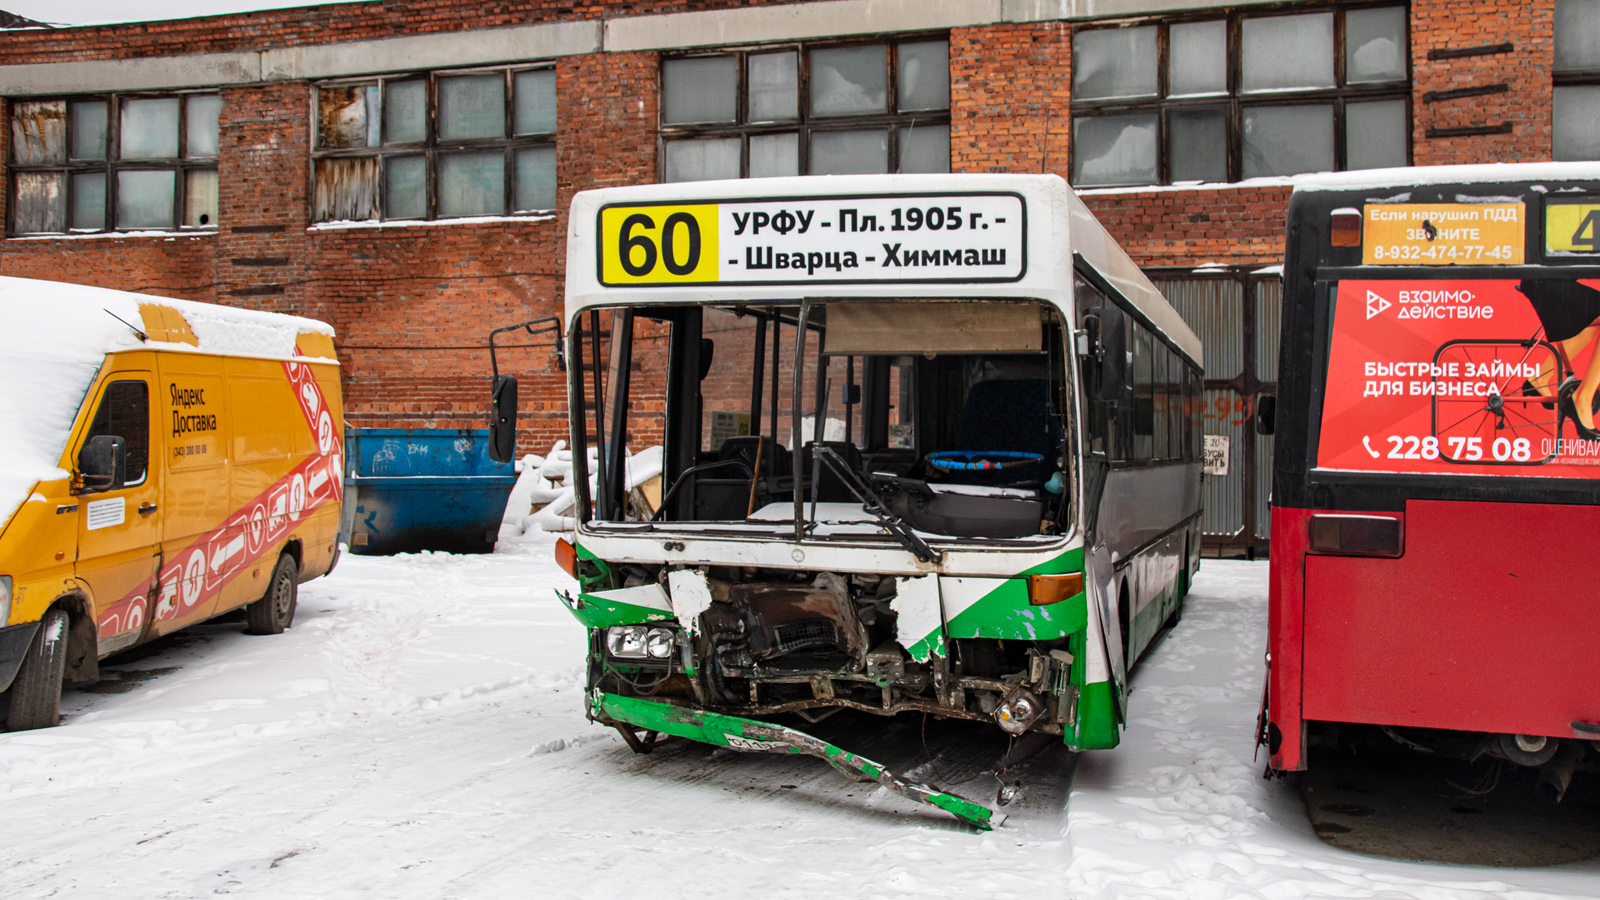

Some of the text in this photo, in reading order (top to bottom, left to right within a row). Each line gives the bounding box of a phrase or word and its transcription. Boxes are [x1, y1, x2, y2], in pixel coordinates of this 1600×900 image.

[731, 209, 815, 236] УРФУ
[839, 208, 885, 233] Пл.
[891, 206, 963, 231] 1905
[969, 212, 989, 230] г.
[1370, 208, 1518, 224] Если нарушил ПДД
[618, 211, 702, 277] 60
[1406, 228, 1480, 240] ЗВНИТЕ
[745, 246, 859, 276] Шварца
[881, 243, 1006, 268] Химмаш
[1374, 245, 1513, 260] 8-932-474-77-45
[1364, 359, 1541, 378] БЫСТРЫЕ ЗАЙМЫ
[170, 382, 205, 409] Яндекс
[1363, 380, 1501, 398] ДЛЯ БИЗНЕСА
[172, 409, 217, 438] Доставка
[1387, 435, 1532, 463] 228 75 08
